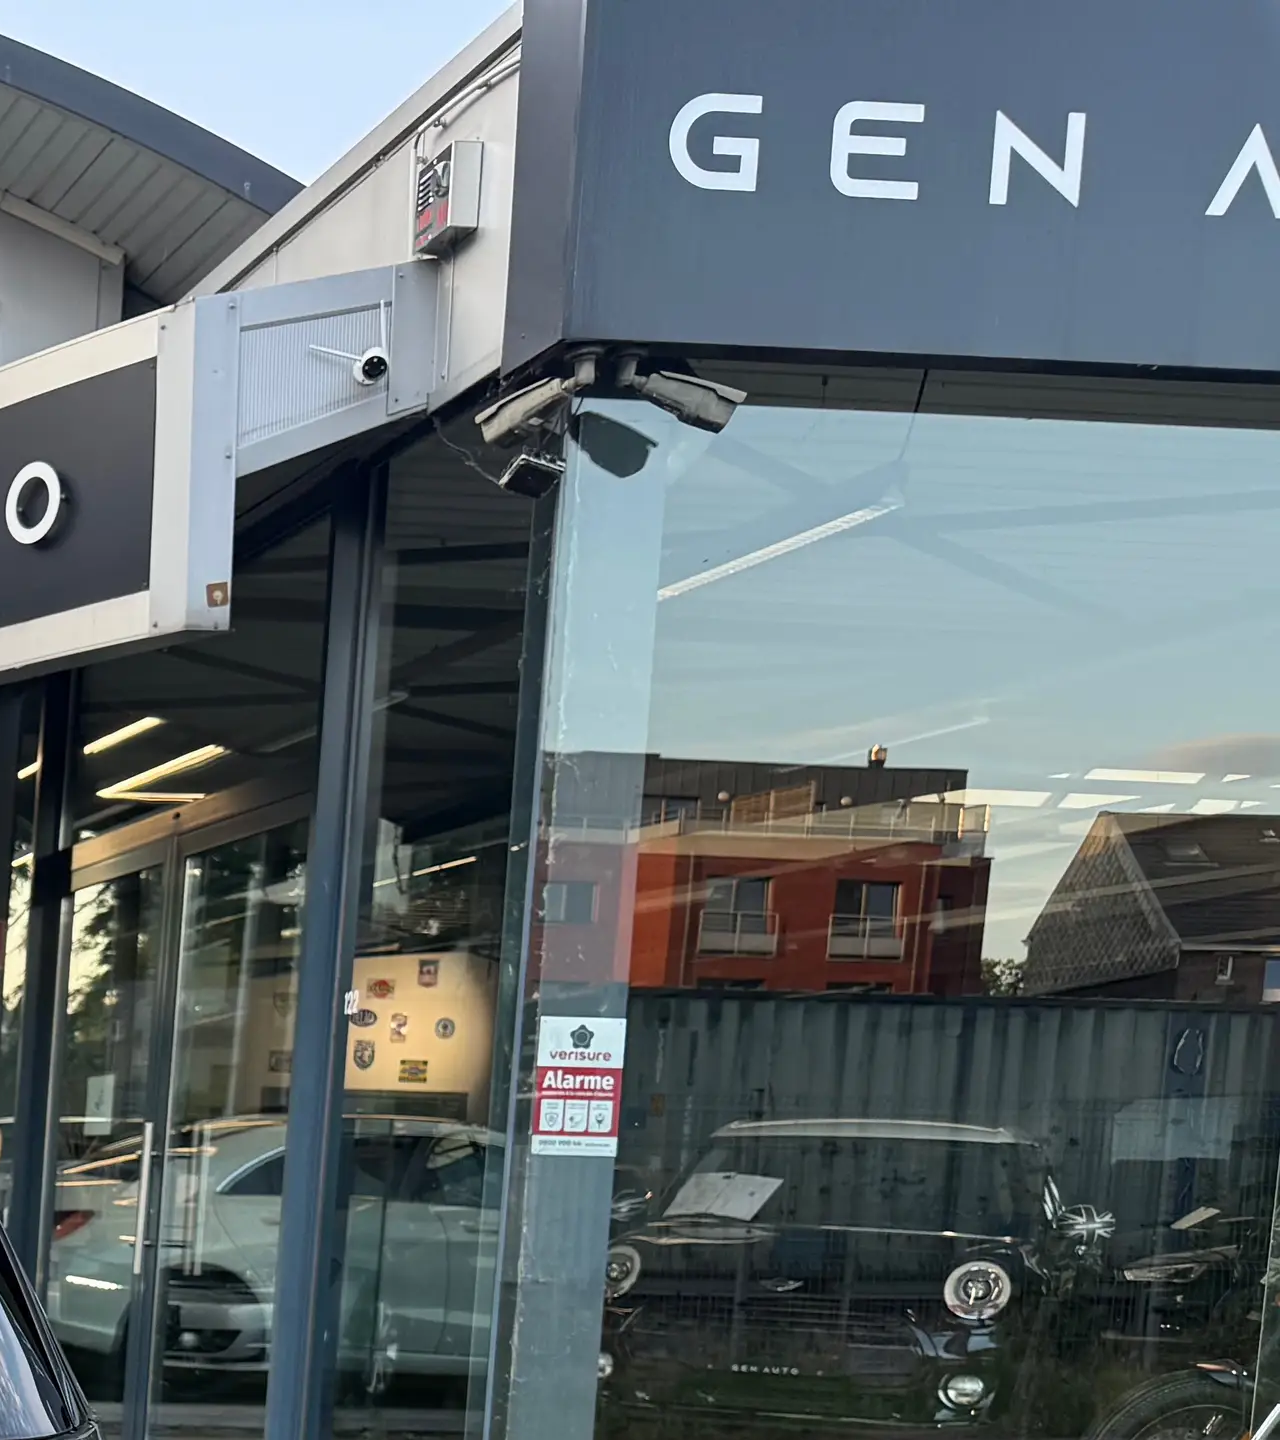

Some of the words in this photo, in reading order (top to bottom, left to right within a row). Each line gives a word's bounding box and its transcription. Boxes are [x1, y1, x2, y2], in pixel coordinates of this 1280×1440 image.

[669, 92, 1087, 208] GEN
[344, 990, 359, 1015] 122
[549, 1050, 612, 1062] verisure
[542, 1069, 615, 1091] Alarme
[762, 1365, 800, 1376] AUTO
